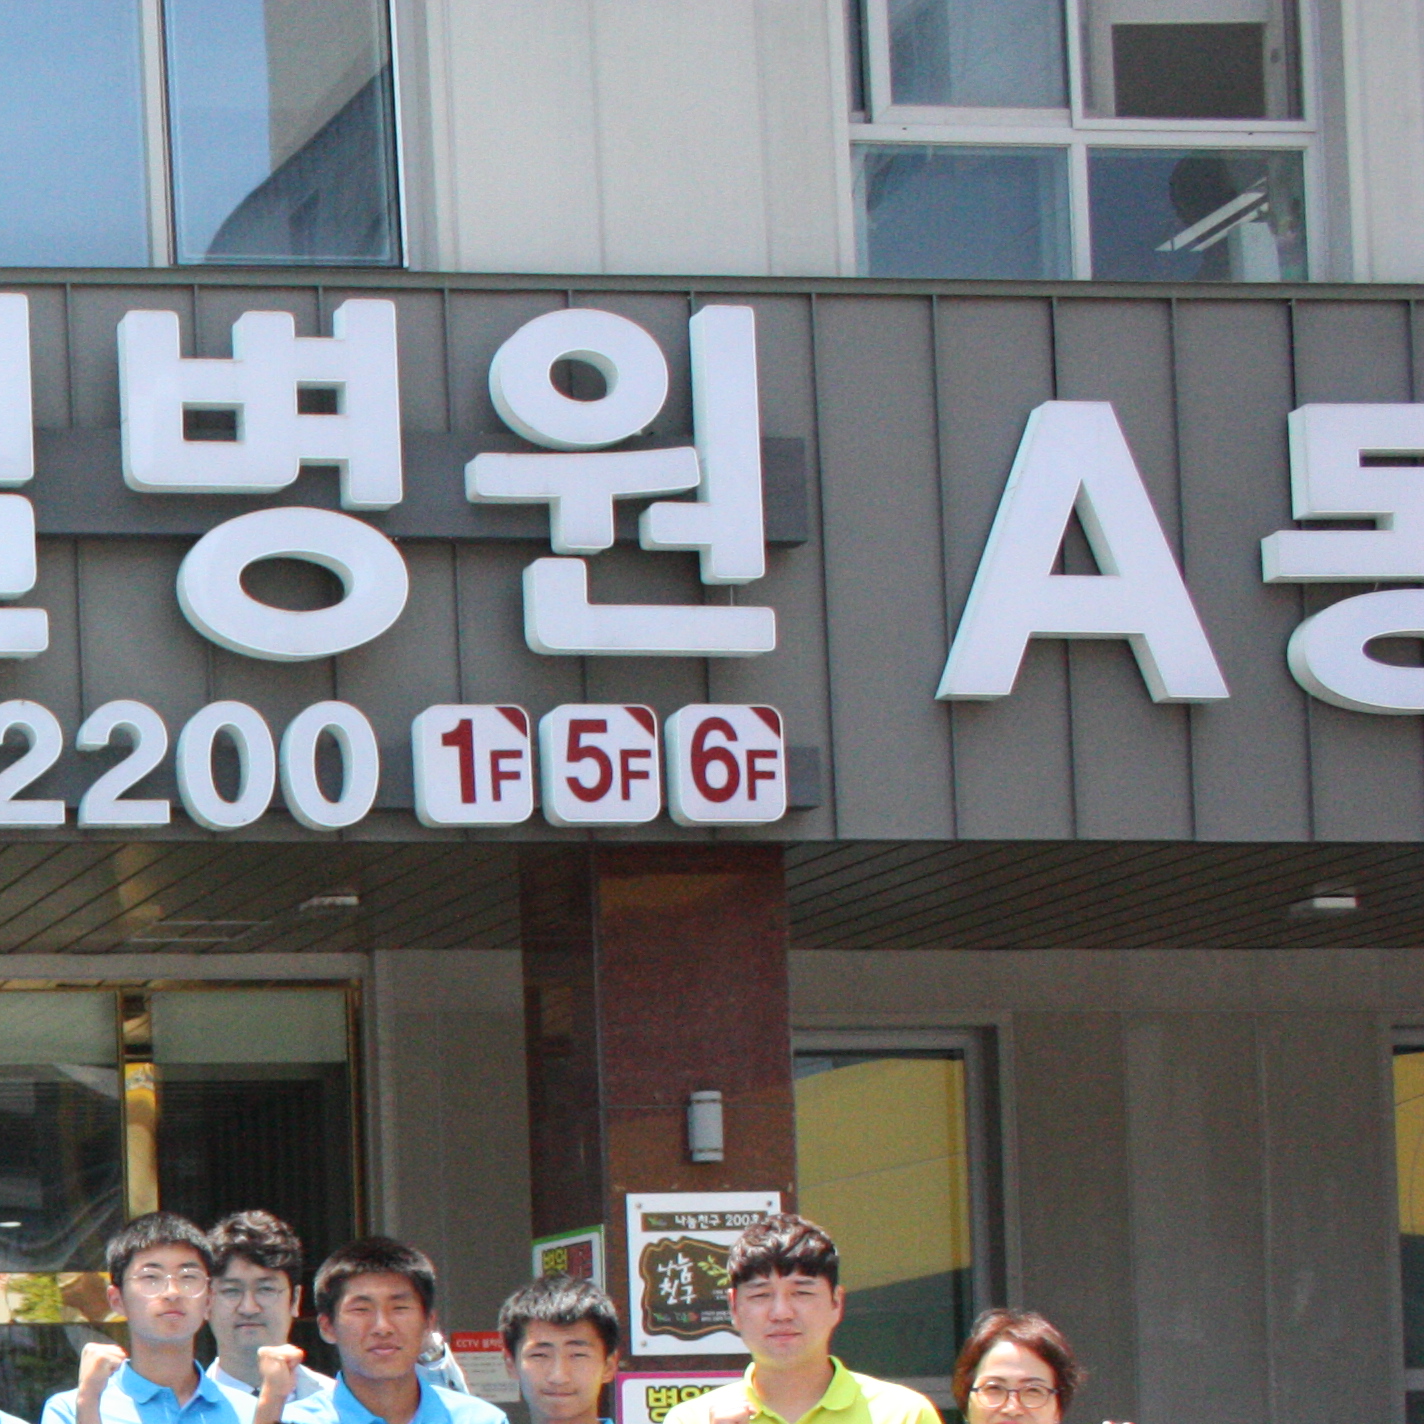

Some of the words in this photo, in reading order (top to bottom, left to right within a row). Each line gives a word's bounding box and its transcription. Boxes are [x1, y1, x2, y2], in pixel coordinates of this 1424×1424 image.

[441, 718, 522, 805] 1F
[565, 718, 651, 804] 5F
[690, 716, 777, 804] 6F
